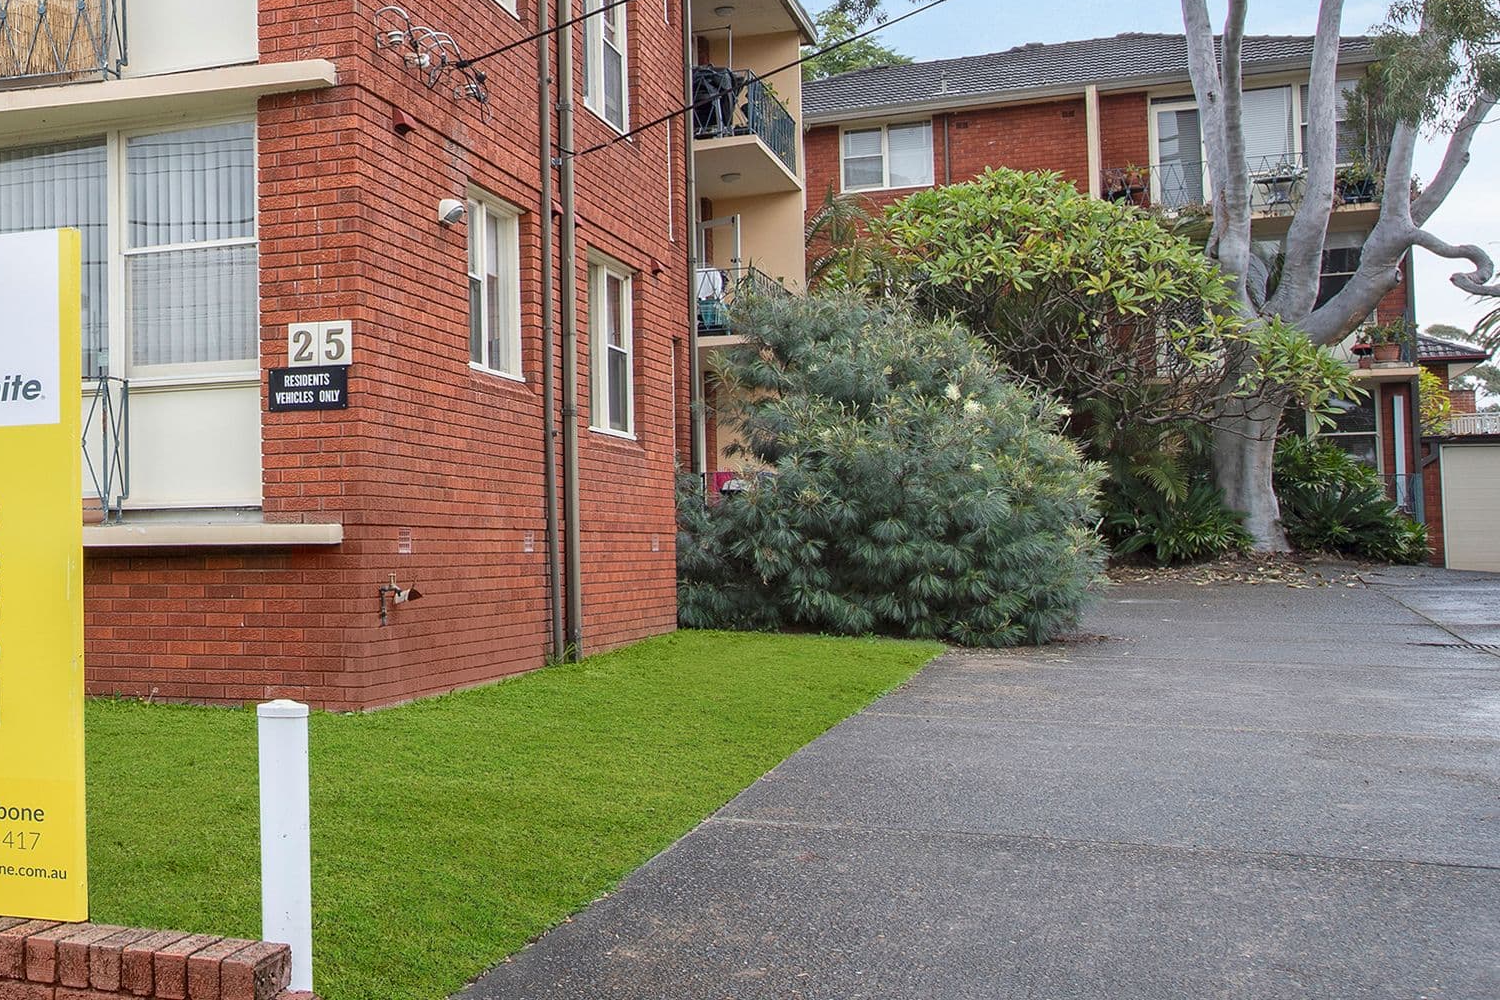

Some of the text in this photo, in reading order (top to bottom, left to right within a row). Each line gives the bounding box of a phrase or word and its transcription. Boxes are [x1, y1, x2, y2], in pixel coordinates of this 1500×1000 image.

[292, 328, 346, 362] 25
[284, 373, 330, 388] RESIDENTS
[275, 389, 341, 405] VEHICLES ONLY
[2, 830, 41, 850] 417
